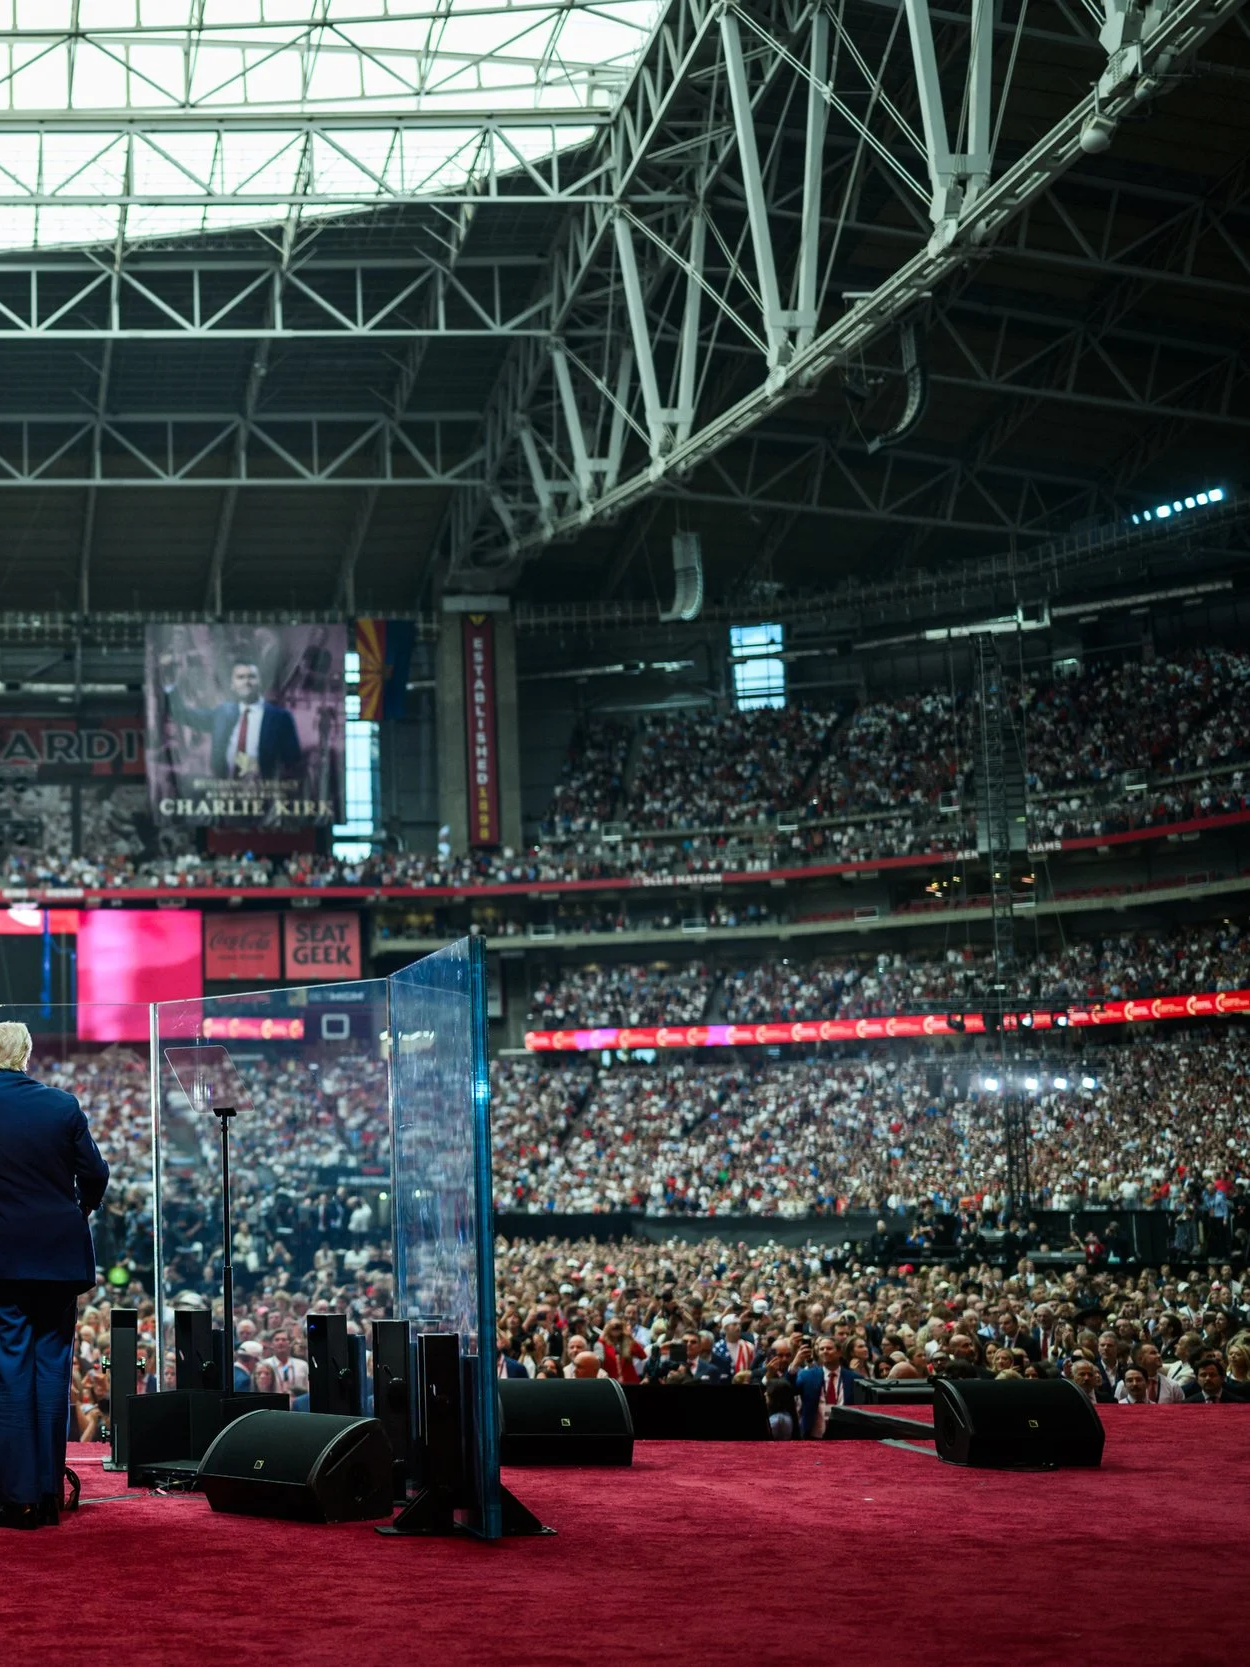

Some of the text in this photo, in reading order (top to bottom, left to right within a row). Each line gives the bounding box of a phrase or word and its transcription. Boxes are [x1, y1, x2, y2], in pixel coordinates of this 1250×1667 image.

[472, 637, 489, 785] ESTABLISHED
[159, 798, 334, 816] CHARLIE KIRK
[956, 850, 979, 860] AEN
[1027, 840, 1061, 853] LIAMS
[296, 922, 350, 942] SEAT
[293, 947, 353, 965] GEEK
